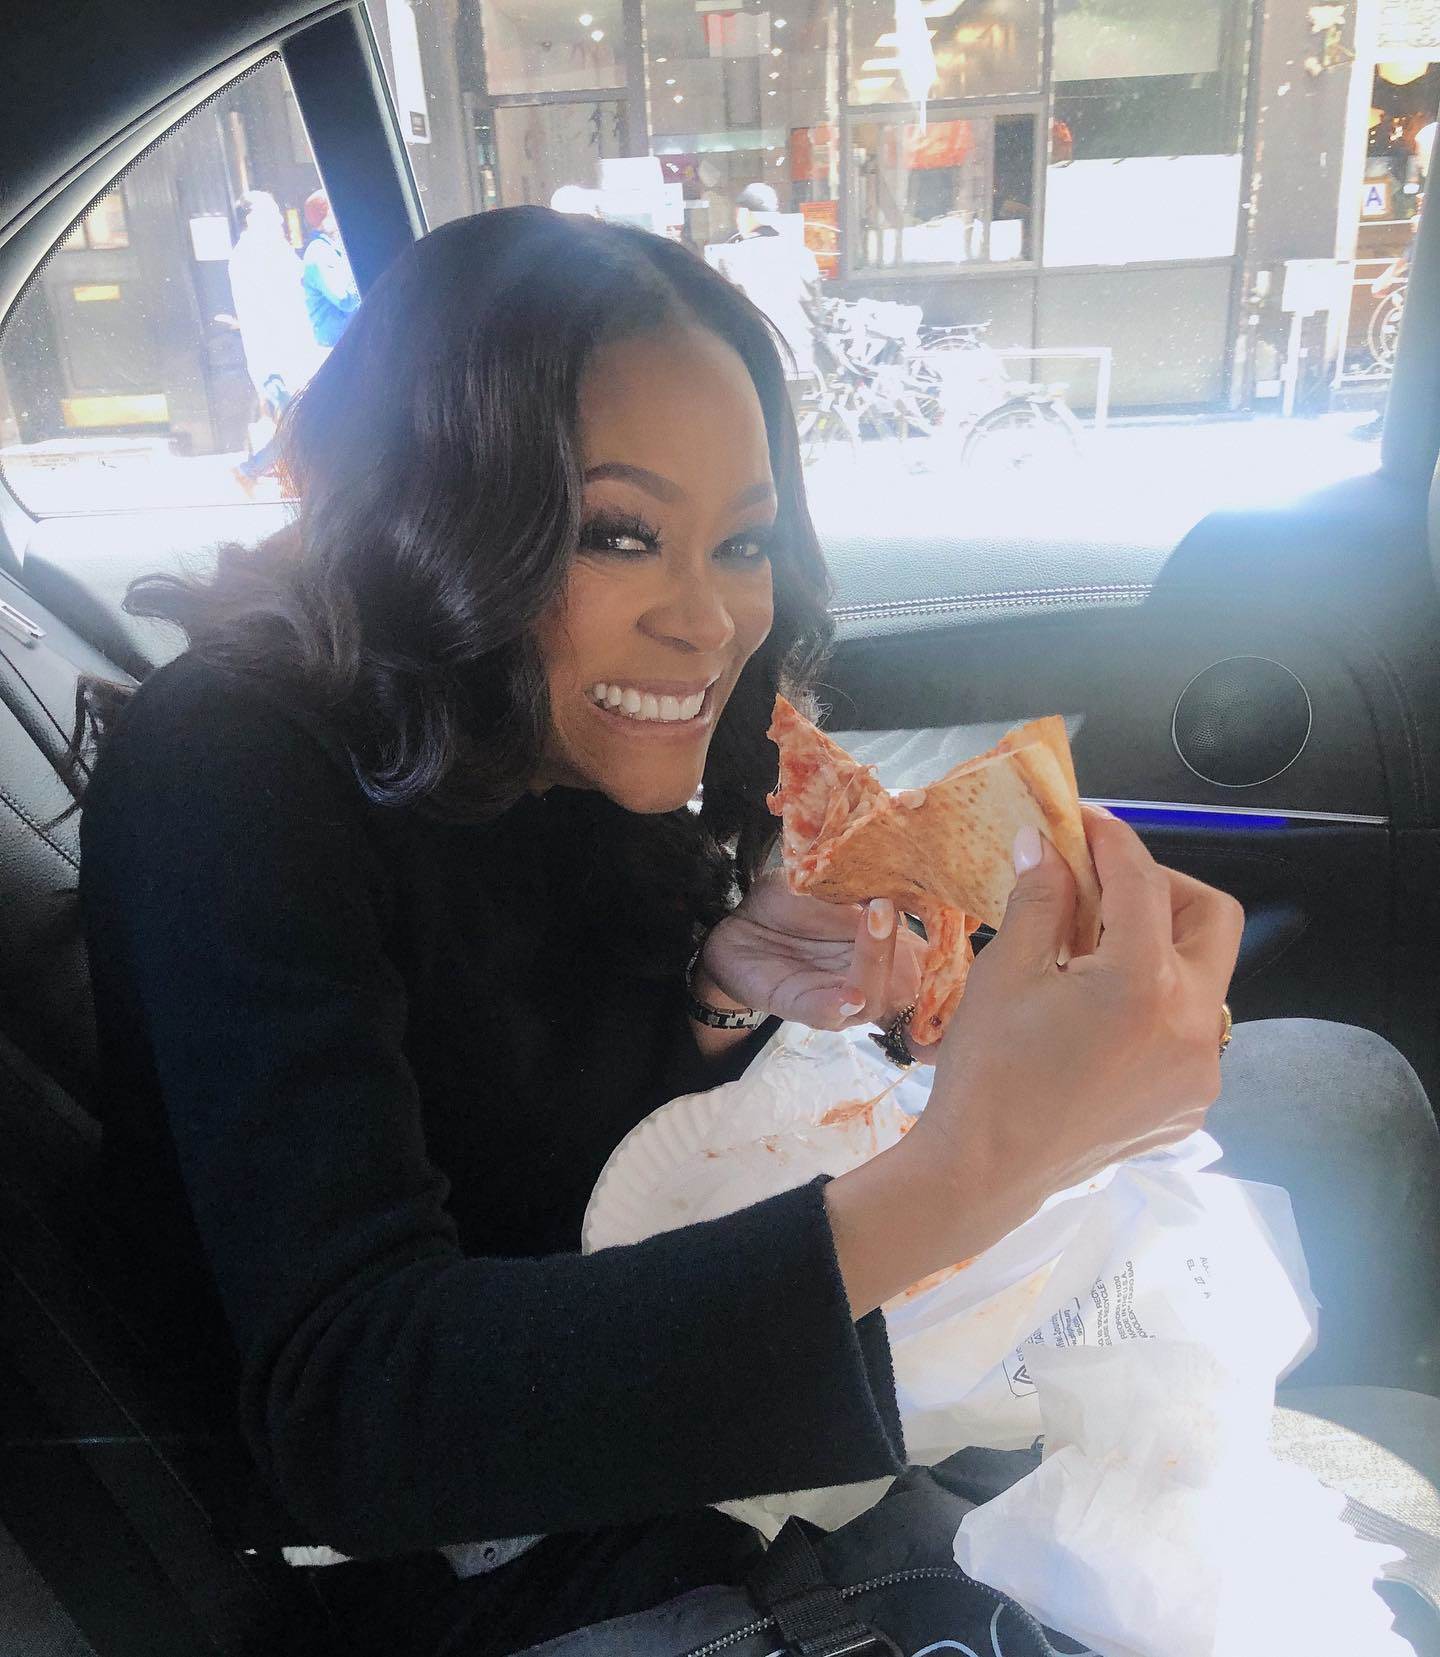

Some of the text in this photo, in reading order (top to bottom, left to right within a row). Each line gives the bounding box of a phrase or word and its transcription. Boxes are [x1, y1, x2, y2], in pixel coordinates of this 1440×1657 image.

[1366, 186, 1382, 206] A
[1126, 1261, 1134, 1278] BAG
[1123, 1319, 1137, 1339] MADE
